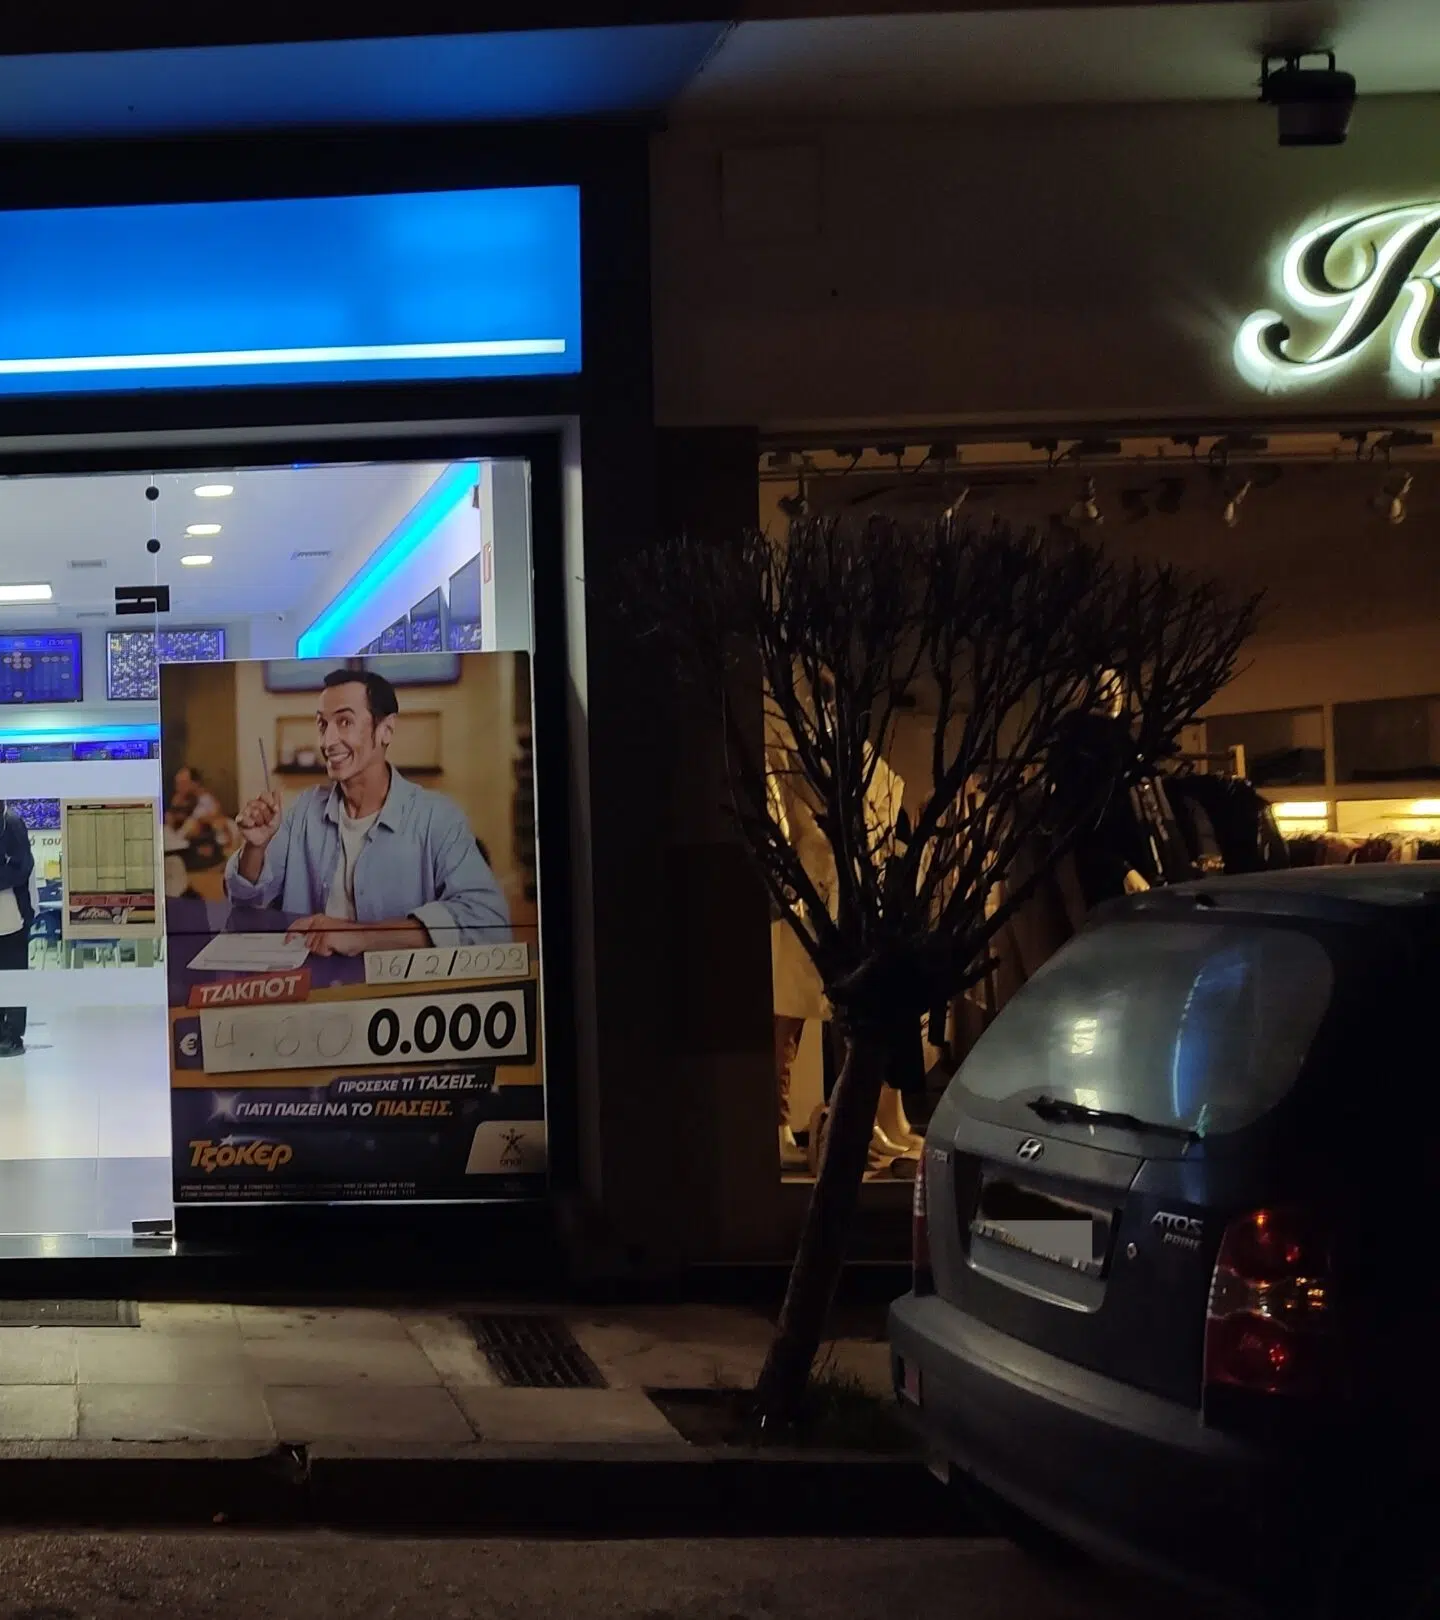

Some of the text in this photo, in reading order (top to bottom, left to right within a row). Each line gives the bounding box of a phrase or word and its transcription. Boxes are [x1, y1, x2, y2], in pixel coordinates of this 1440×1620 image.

[200, 975, 302, 1002] ΤΖΑΚΠΟΤ
[338, 1078, 399, 1094] ΠΡΟΣΕΧΕ
[236, 1102, 272, 1117] ΓΙΑΤΙ
[274, 1102, 323, 1117] ΠΑΙΖΕΙ
[324, 1102, 350, 1117] ΝΑ
[351, 1101, 373, 1117] ΤΟ
[1150, 1210, 1205, 1237] ATOS
